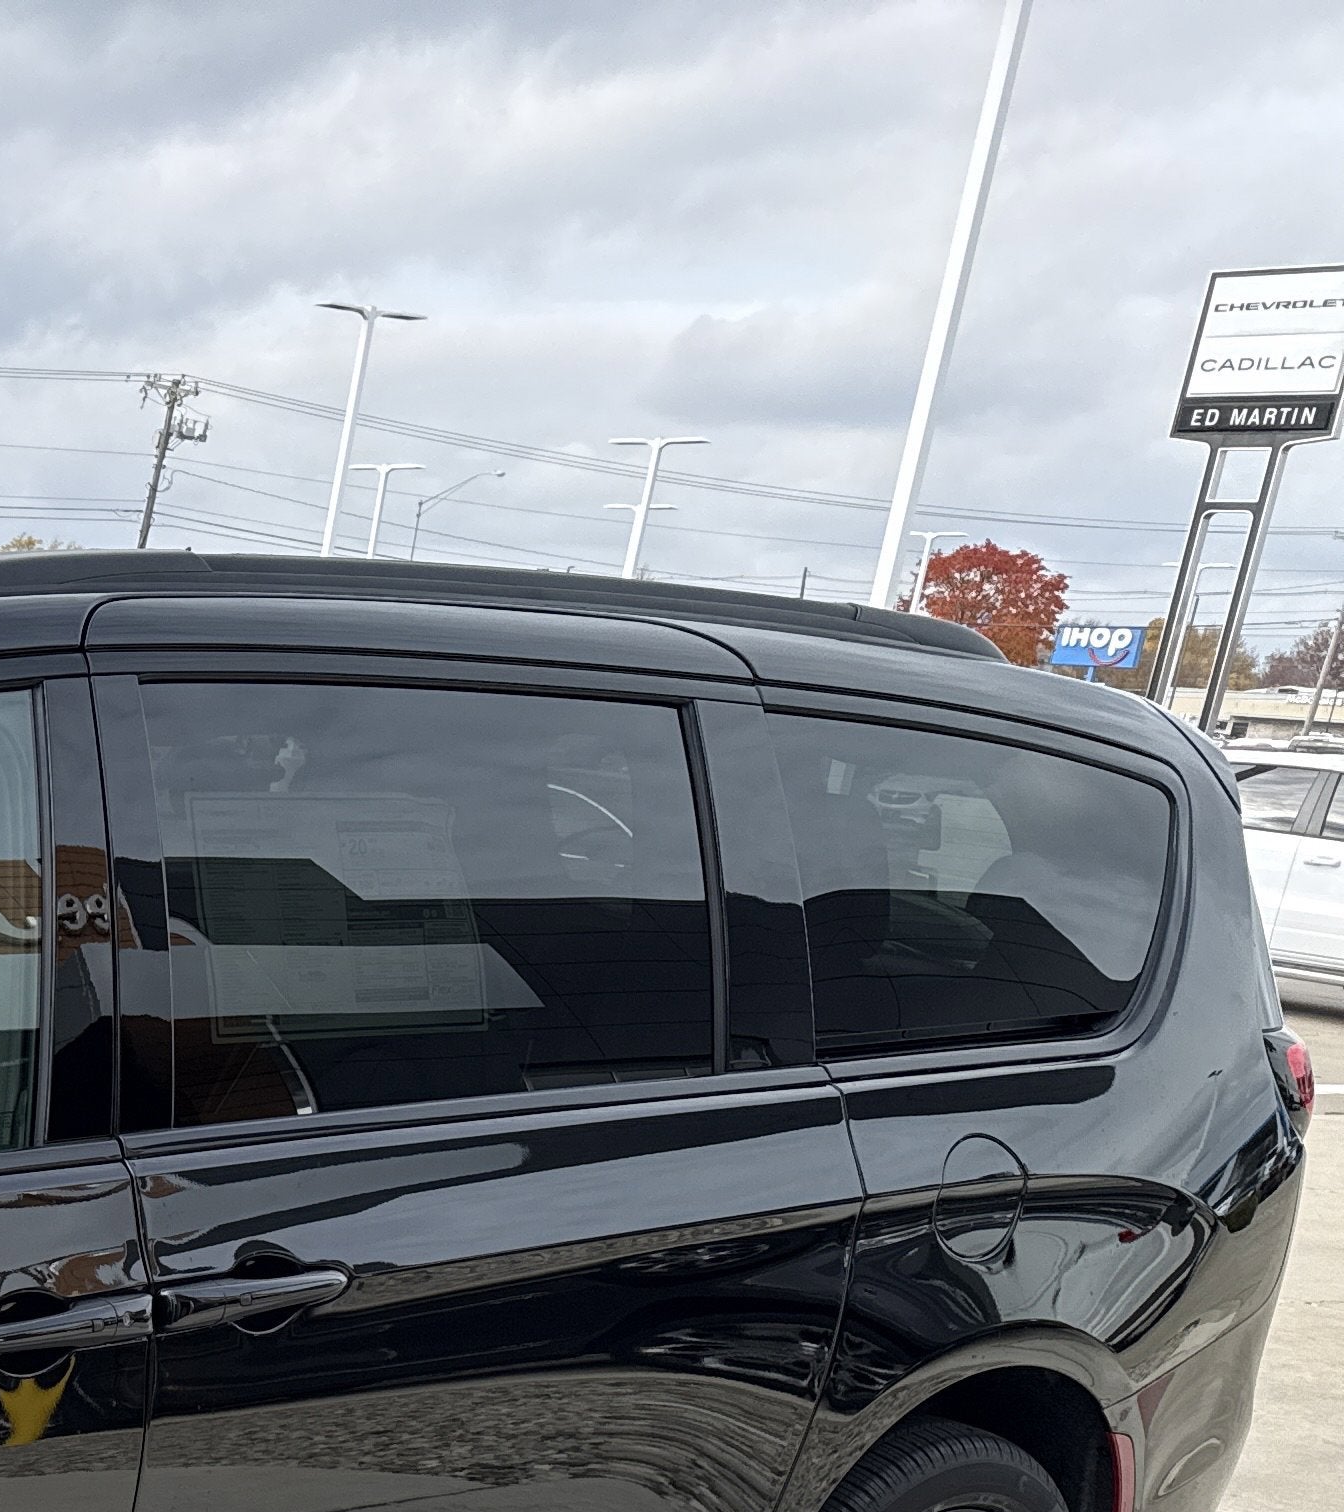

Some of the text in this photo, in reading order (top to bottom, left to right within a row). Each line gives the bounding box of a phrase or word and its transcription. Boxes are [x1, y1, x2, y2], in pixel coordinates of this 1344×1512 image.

[1200, 355, 1337, 373] CADILLAC
[1190, 406, 1318, 426] ED MARTIN
[1061, 626, 1133, 657] IHOP
